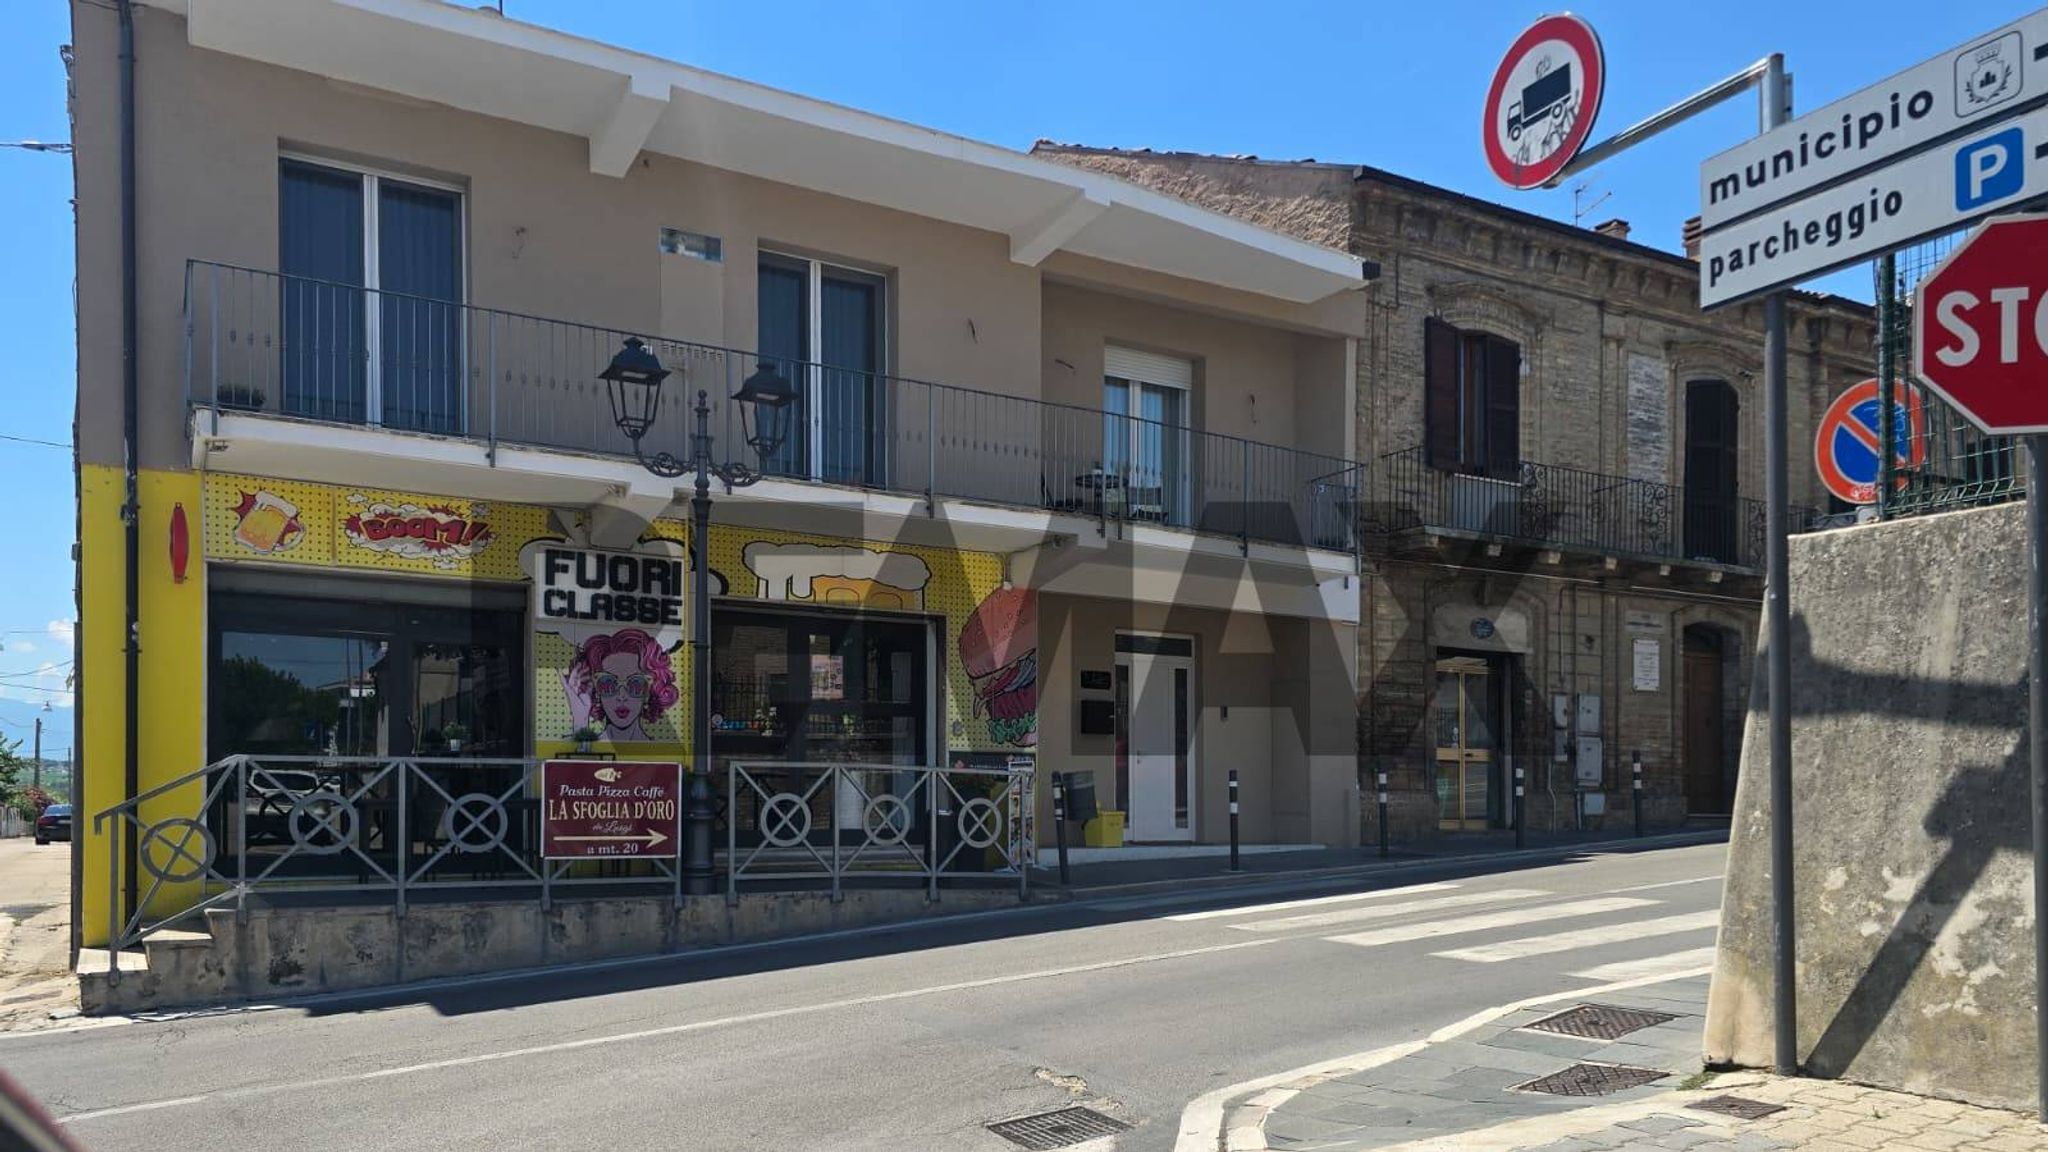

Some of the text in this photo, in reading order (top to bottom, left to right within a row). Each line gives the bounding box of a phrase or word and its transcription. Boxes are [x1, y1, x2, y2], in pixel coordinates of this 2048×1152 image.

[1710, 90, 1934, 205] municipio
[1710, 143, 2008, 287] parcheggio P
[1936, 287, 2048, 368] ST
[361, 518, 489, 547] BOOM!
[545, 550, 682, 596] FUORI
[544, 589, 682, 625] CLASSE
[560, 785, 593, 797] Pasta
[598, 785, 630, 798] Pizza
[549, 800, 675, 820] LA SFOGLIA D'ORO
[598, 843, 620, 854] mt.
[623, 842, 639, 854] 20
